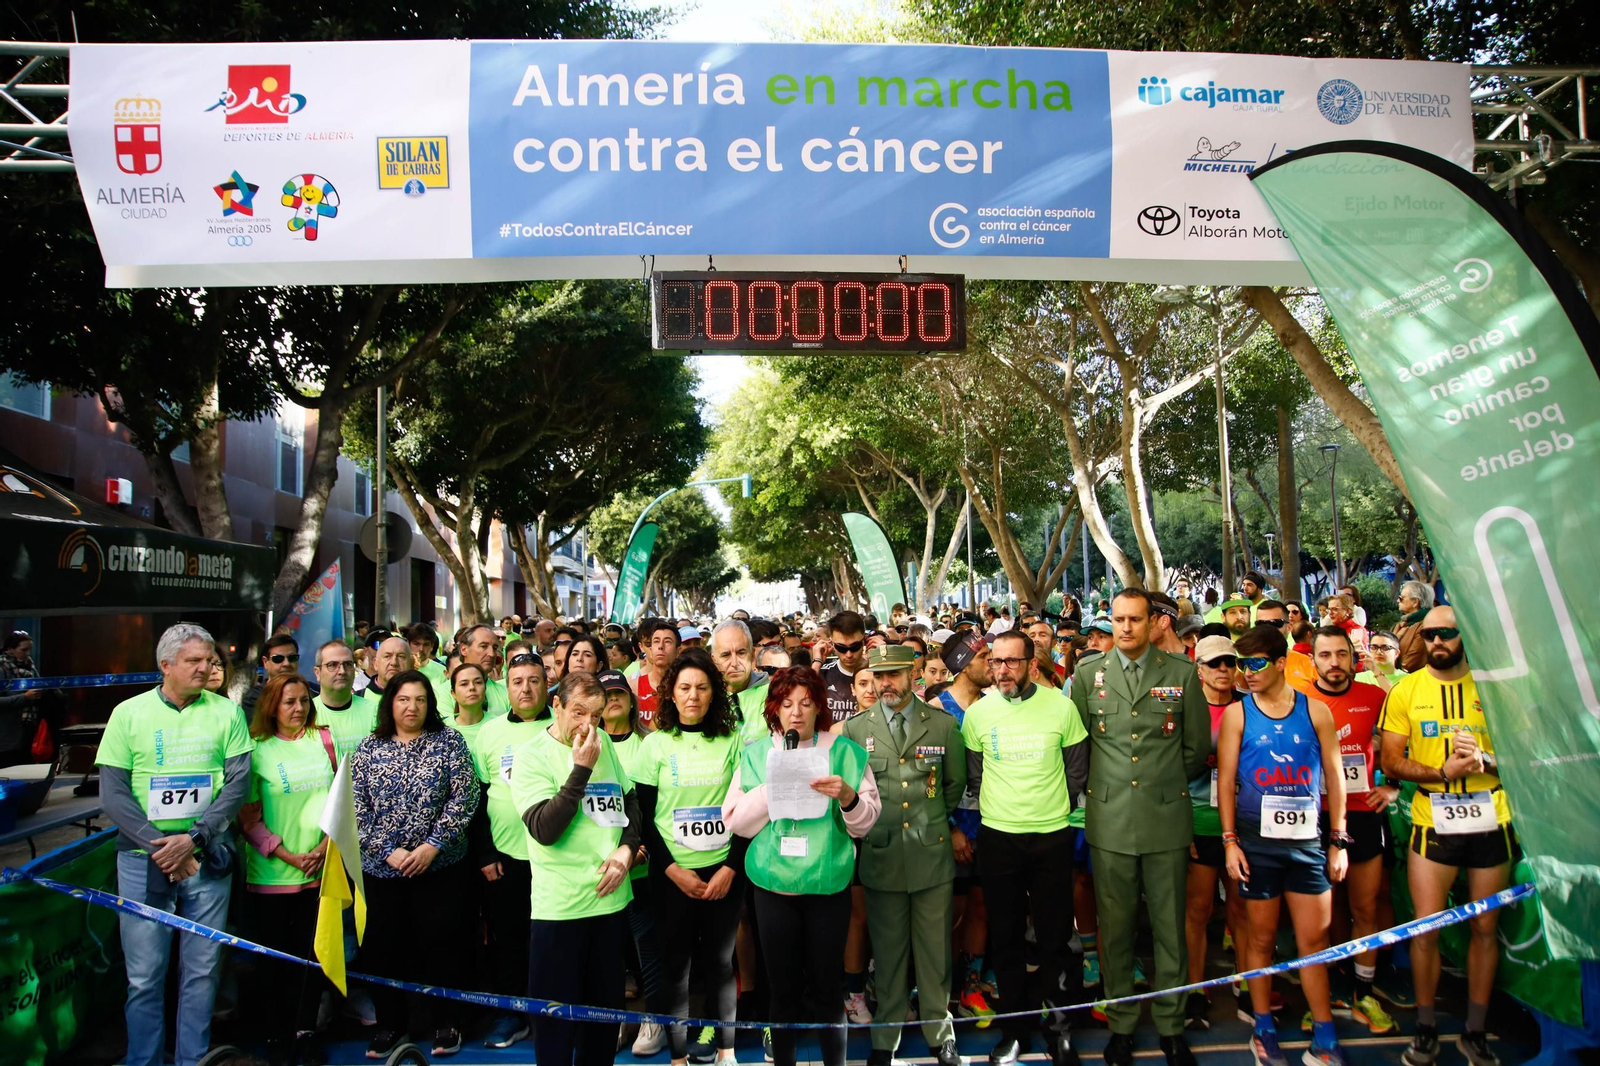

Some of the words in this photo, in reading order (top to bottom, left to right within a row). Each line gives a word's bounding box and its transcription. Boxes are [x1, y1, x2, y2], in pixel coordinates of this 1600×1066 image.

[513, 63, 745, 106] Almería
[765, 73, 835, 105] en
[858, 69, 1073, 112] marcha
[1180, 81, 1285, 108] cajamar
[1364, 90, 1451, 105] UNIVERSIDAD
[1232, 104, 1254, 112] CAJA
[1256, 105, 1284, 113] RURAL
[1364, 103, 1385, 115] DE
[1389, 105, 1452, 118] ALMERÍA
[223, 132, 283, 142] DEPORTES
[286, 132, 301, 141] DE
[512, 126, 708, 173] contra
[727, 126, 783, 173] el
[800, 126, 1003, 174] cáncer
[386, 163, 399, 176] DE
[403, 163, 441, 176] CABRAS
[1183, 163, 1255, 173] MICHELIN
[97, 183, 185, 205] ALMERÍA
[977, 206, 1042, 218] asociación
[1044, 207, 1095, 220] española
[1345, 196, 1388, 216] Ejido
[1394, 196, 1446, 211] Motor
[121, 208, 167, 220] CIUDAD
[1189, 206, 1241, 222] Toyota
[248, 225, 272, 234] 2005
[499, 222, 693, 239] #TodosContraElCáncer
[979, 220, 1017, 231] contra
[1019, 220, 1030, 231] el
[1032, 220, 1071, 232] cáncer
[1189, 225, 1247, 239] Alborán
[1253, 225, 1290, 239] Moto
[979, 235, 995, 244] en
[997, 234, 1044, 245] Almería
[151, 576, 200, 589] cronometraje
[1255, 765, 1312, 787] GALO
[161, 788, 199, 805] 871
[586, 797, 623, 813] 1545
[1444, 805, 1482, 820] 398
[1274, 811, 1306, 825] 691
[679, 820, 726, 837] 1600
